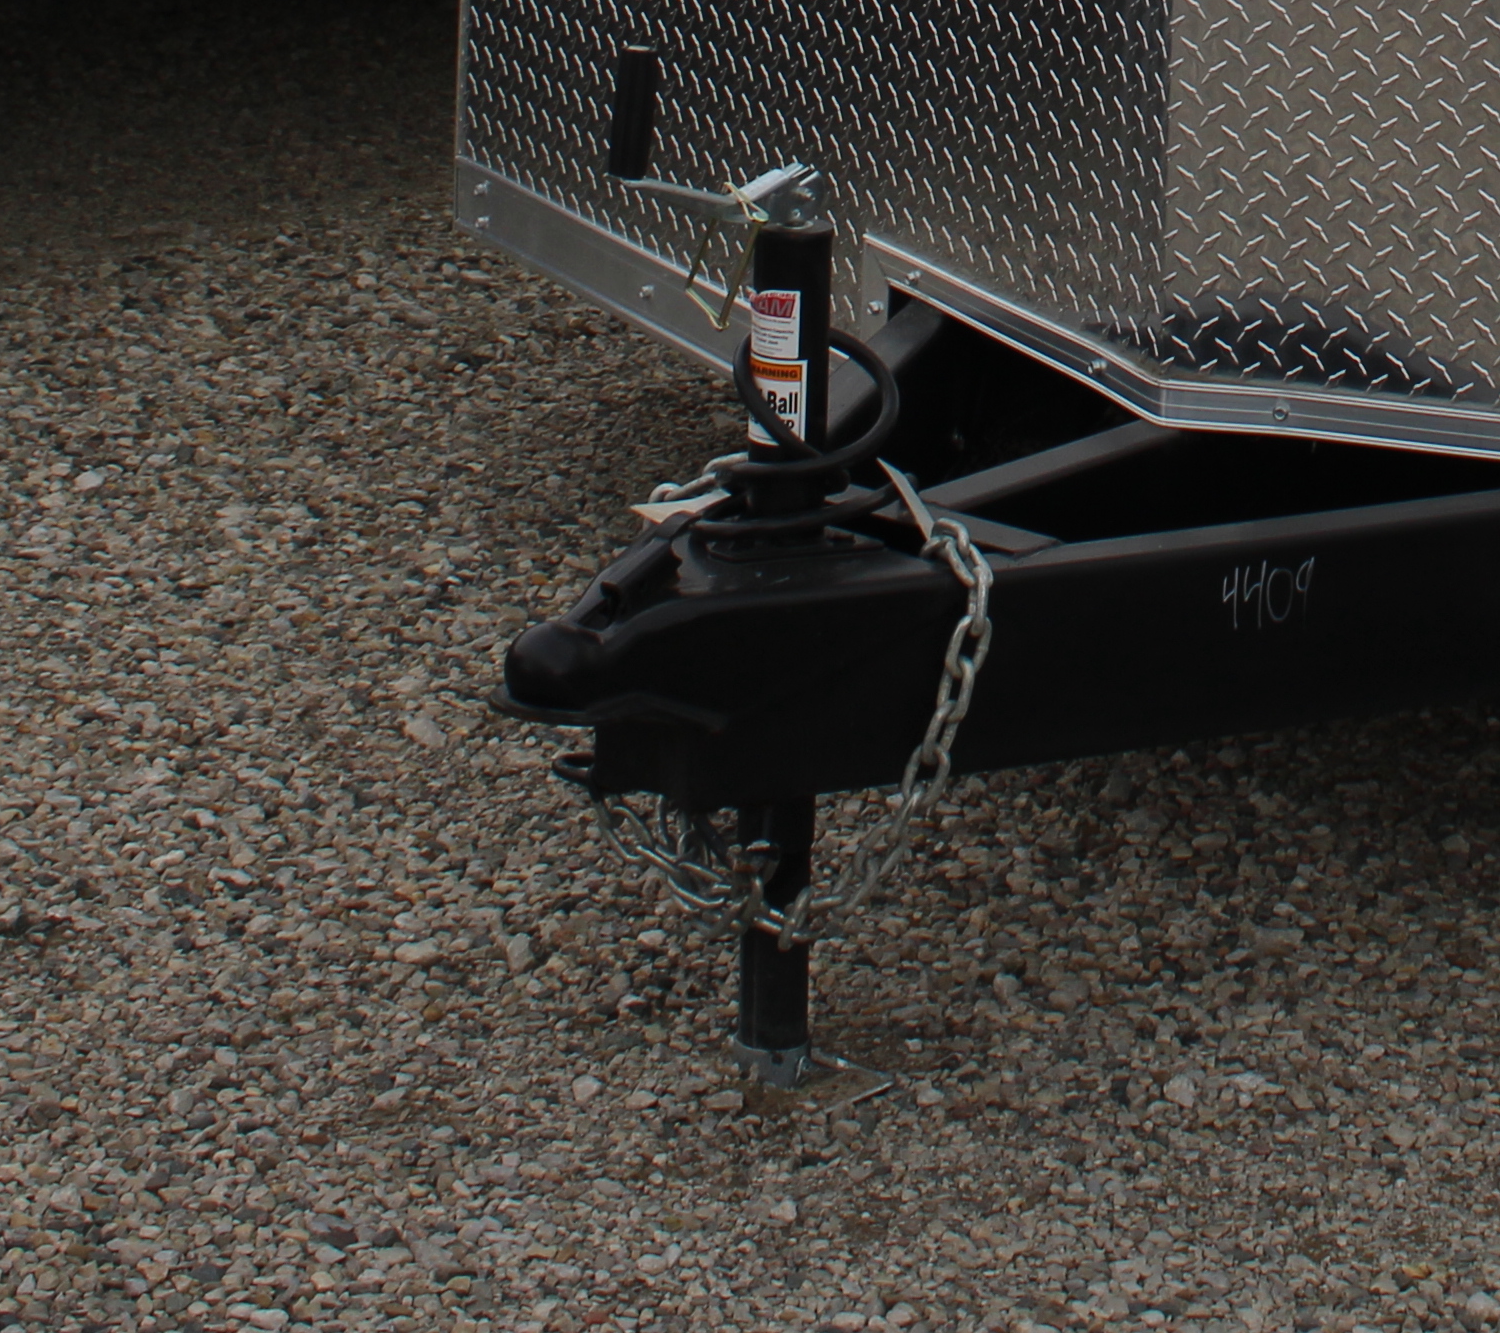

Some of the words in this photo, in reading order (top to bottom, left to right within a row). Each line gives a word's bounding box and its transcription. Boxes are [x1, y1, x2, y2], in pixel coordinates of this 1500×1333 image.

[755, 299, 794, 317] AM
[767, 390, 798, 414] Ball
[1222, 555, 1316, 631] 4409
